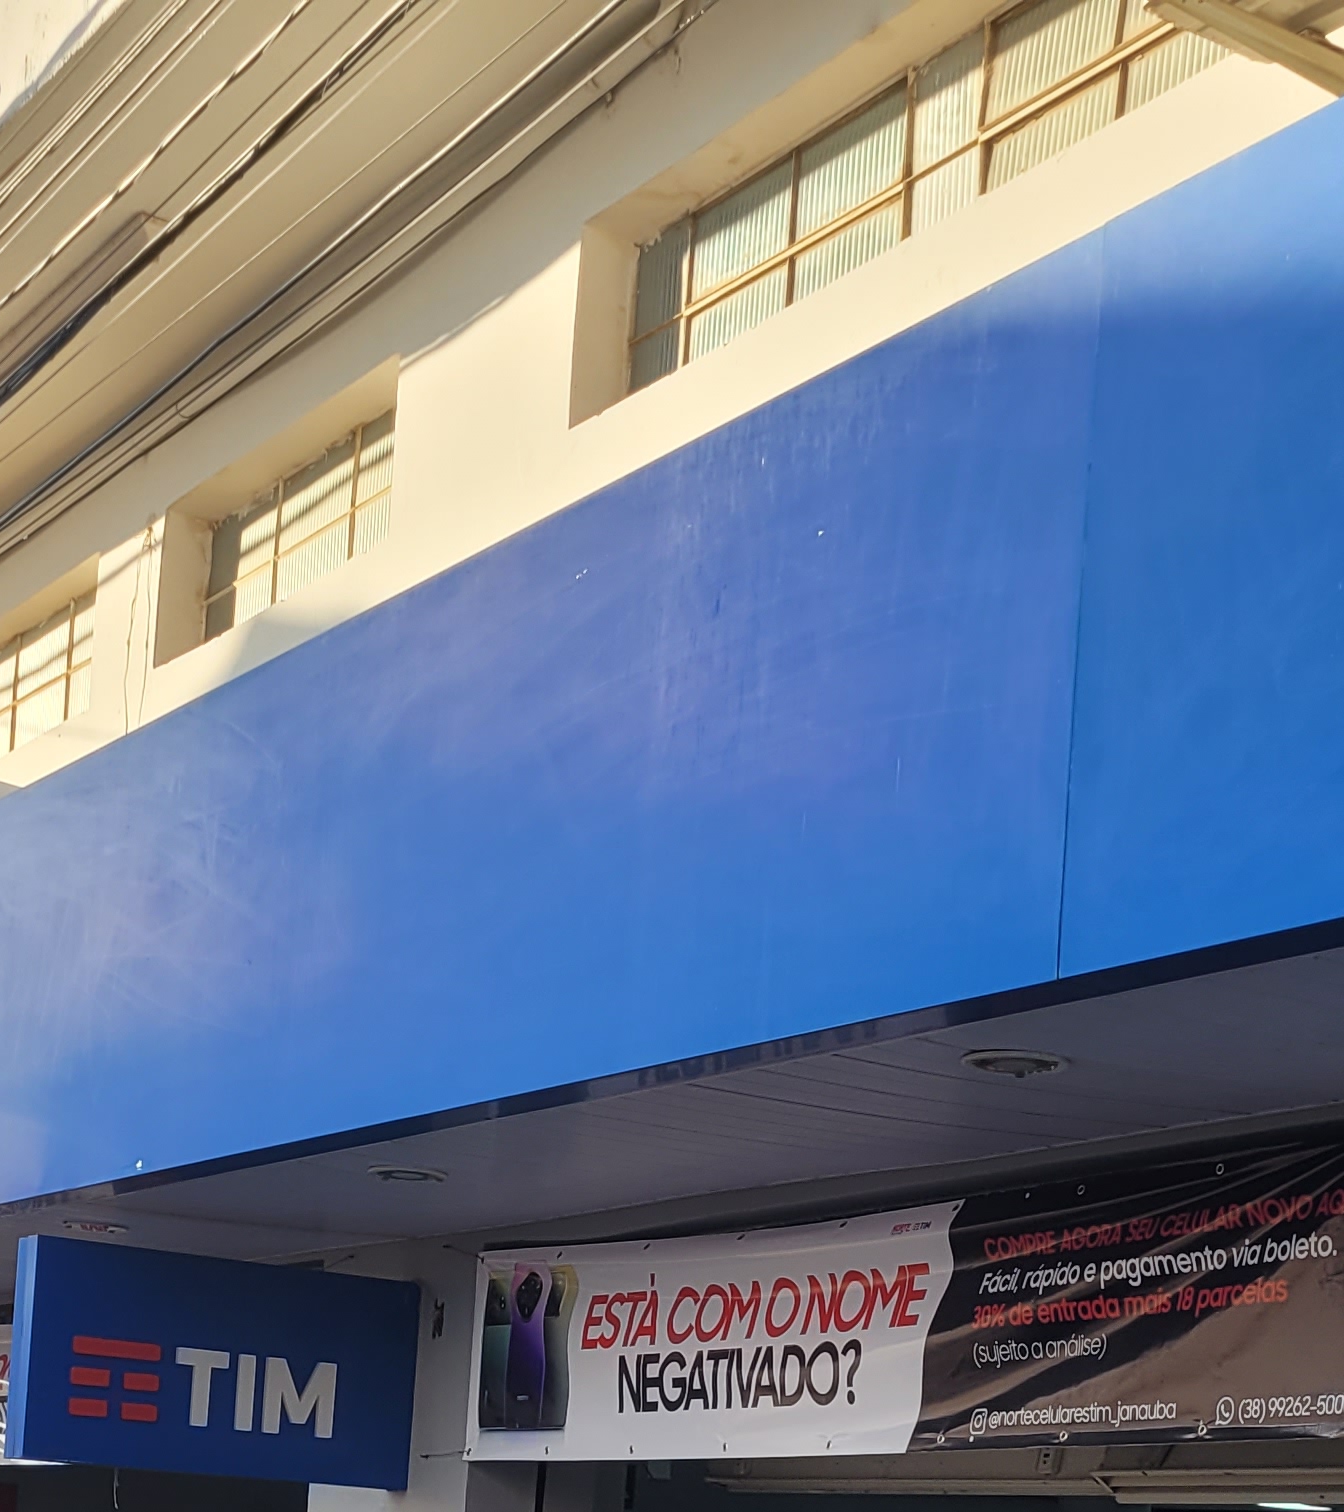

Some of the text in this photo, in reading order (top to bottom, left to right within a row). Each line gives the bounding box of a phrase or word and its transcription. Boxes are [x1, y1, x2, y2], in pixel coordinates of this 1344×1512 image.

[983, 1231, 1056, 1262] COMPRE
[1059, 1222, 1123, 1253] AGORA
[1125, 1216, 1157, 1244] SEU
[1159, 1203, 1244, 1238] CELULAR
[1246, 1194, 1313, 1227] NOVO
[978, 1230, 1340, 1296] Fácil, rápido e pagamento via boleto.
[581, 1262, 930, 1350] ESTÁ COM O NOME
[971, 1276, 1290, 1329] 30% de entrada mais 18 parcelas
[617, 1338, 862, 1414] NEGATIVADO?
[972, 1332, 1109, 1369] (sujeito a análise)
[175, 1346, 338, 1439] TIM
[1238, 1397, 1268, 1424] (38)
